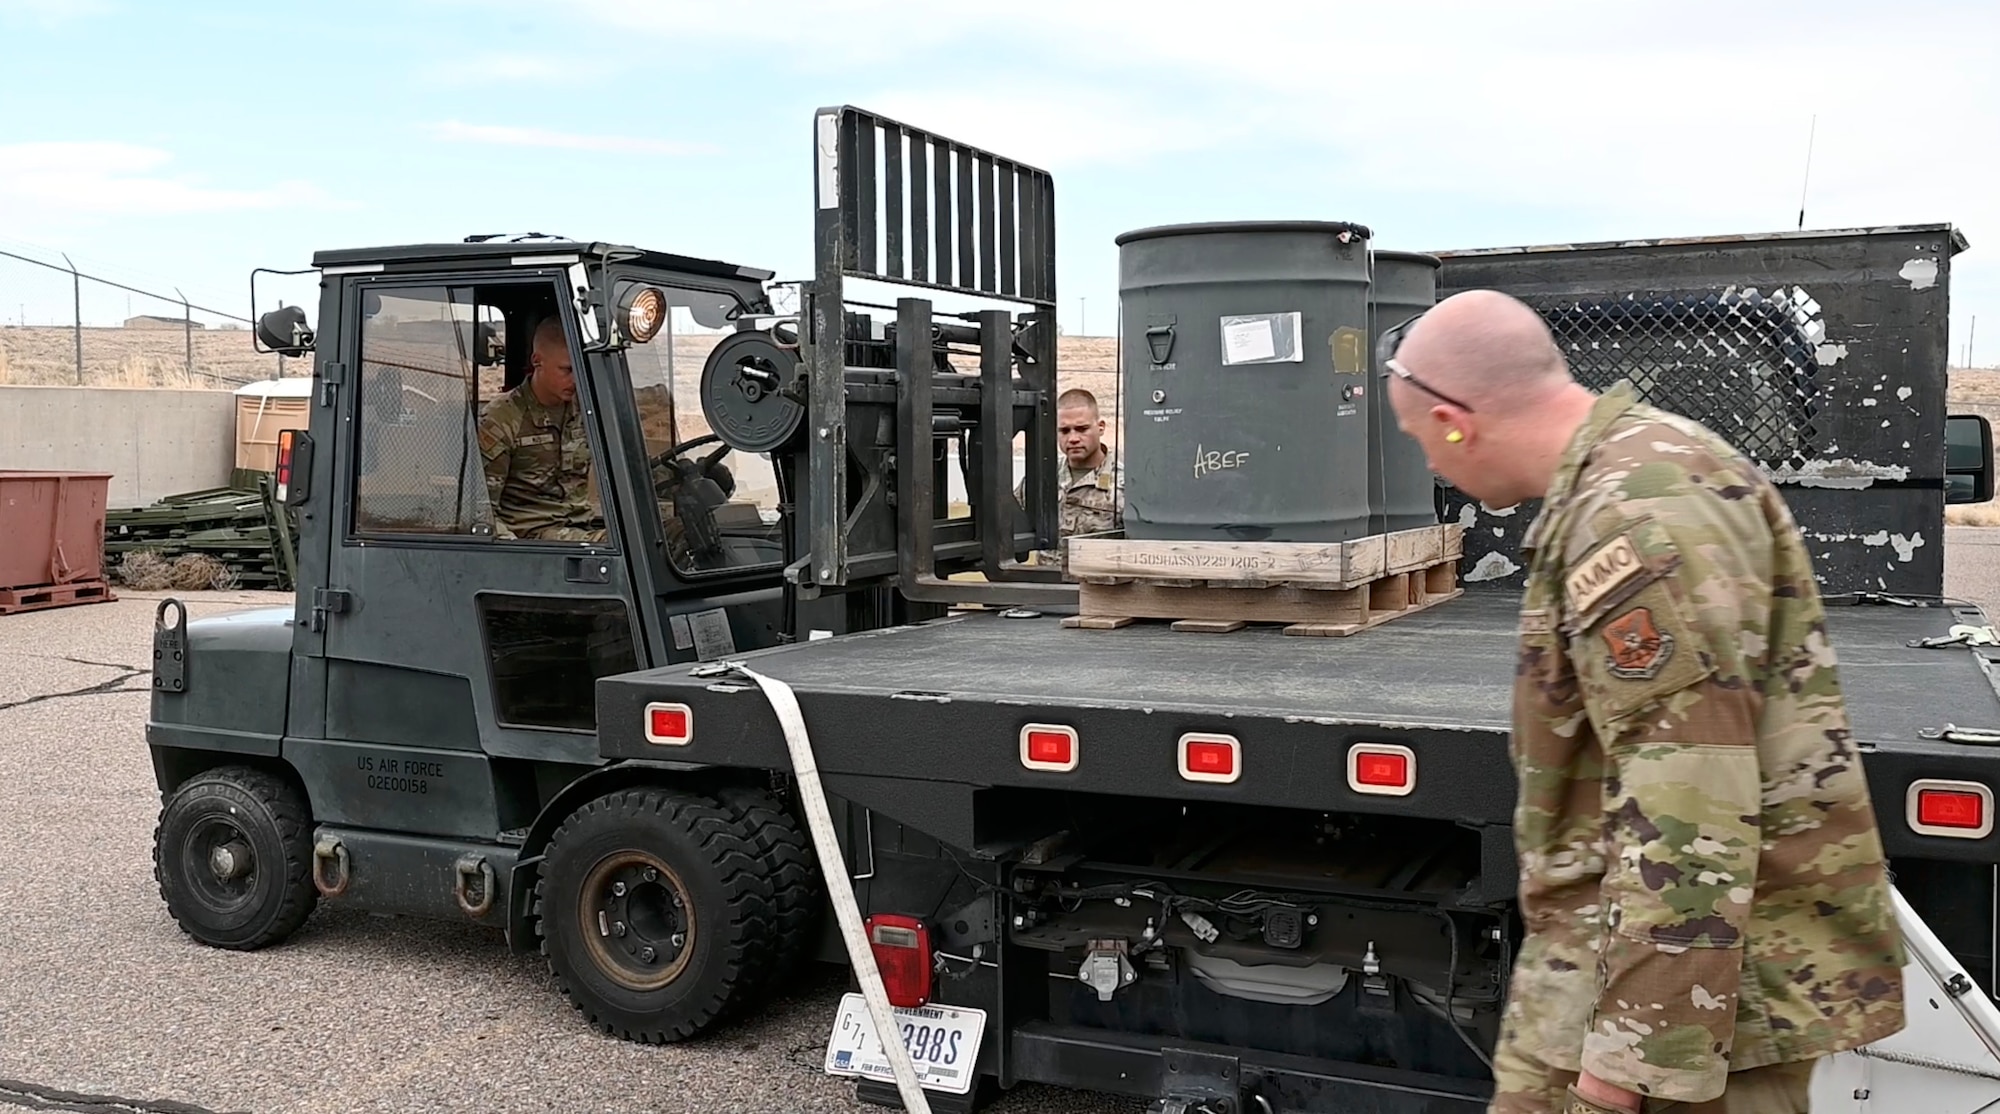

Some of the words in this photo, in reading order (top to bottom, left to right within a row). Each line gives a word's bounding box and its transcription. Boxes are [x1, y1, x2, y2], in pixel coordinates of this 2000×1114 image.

[1194, 443, 1250, 479] ABEF
[1572, 545, 1632, 597] AMMO
[357, 756, 374, 771] US
[378, 758, 399, 774] AIR
[404, 760, 445, 778] FORCE
[367, 774, 428, 795] 02E00158
[893, 1007, 945, 1020] GOVERNMENT
[896, 1022, 963, 1065] 398S
